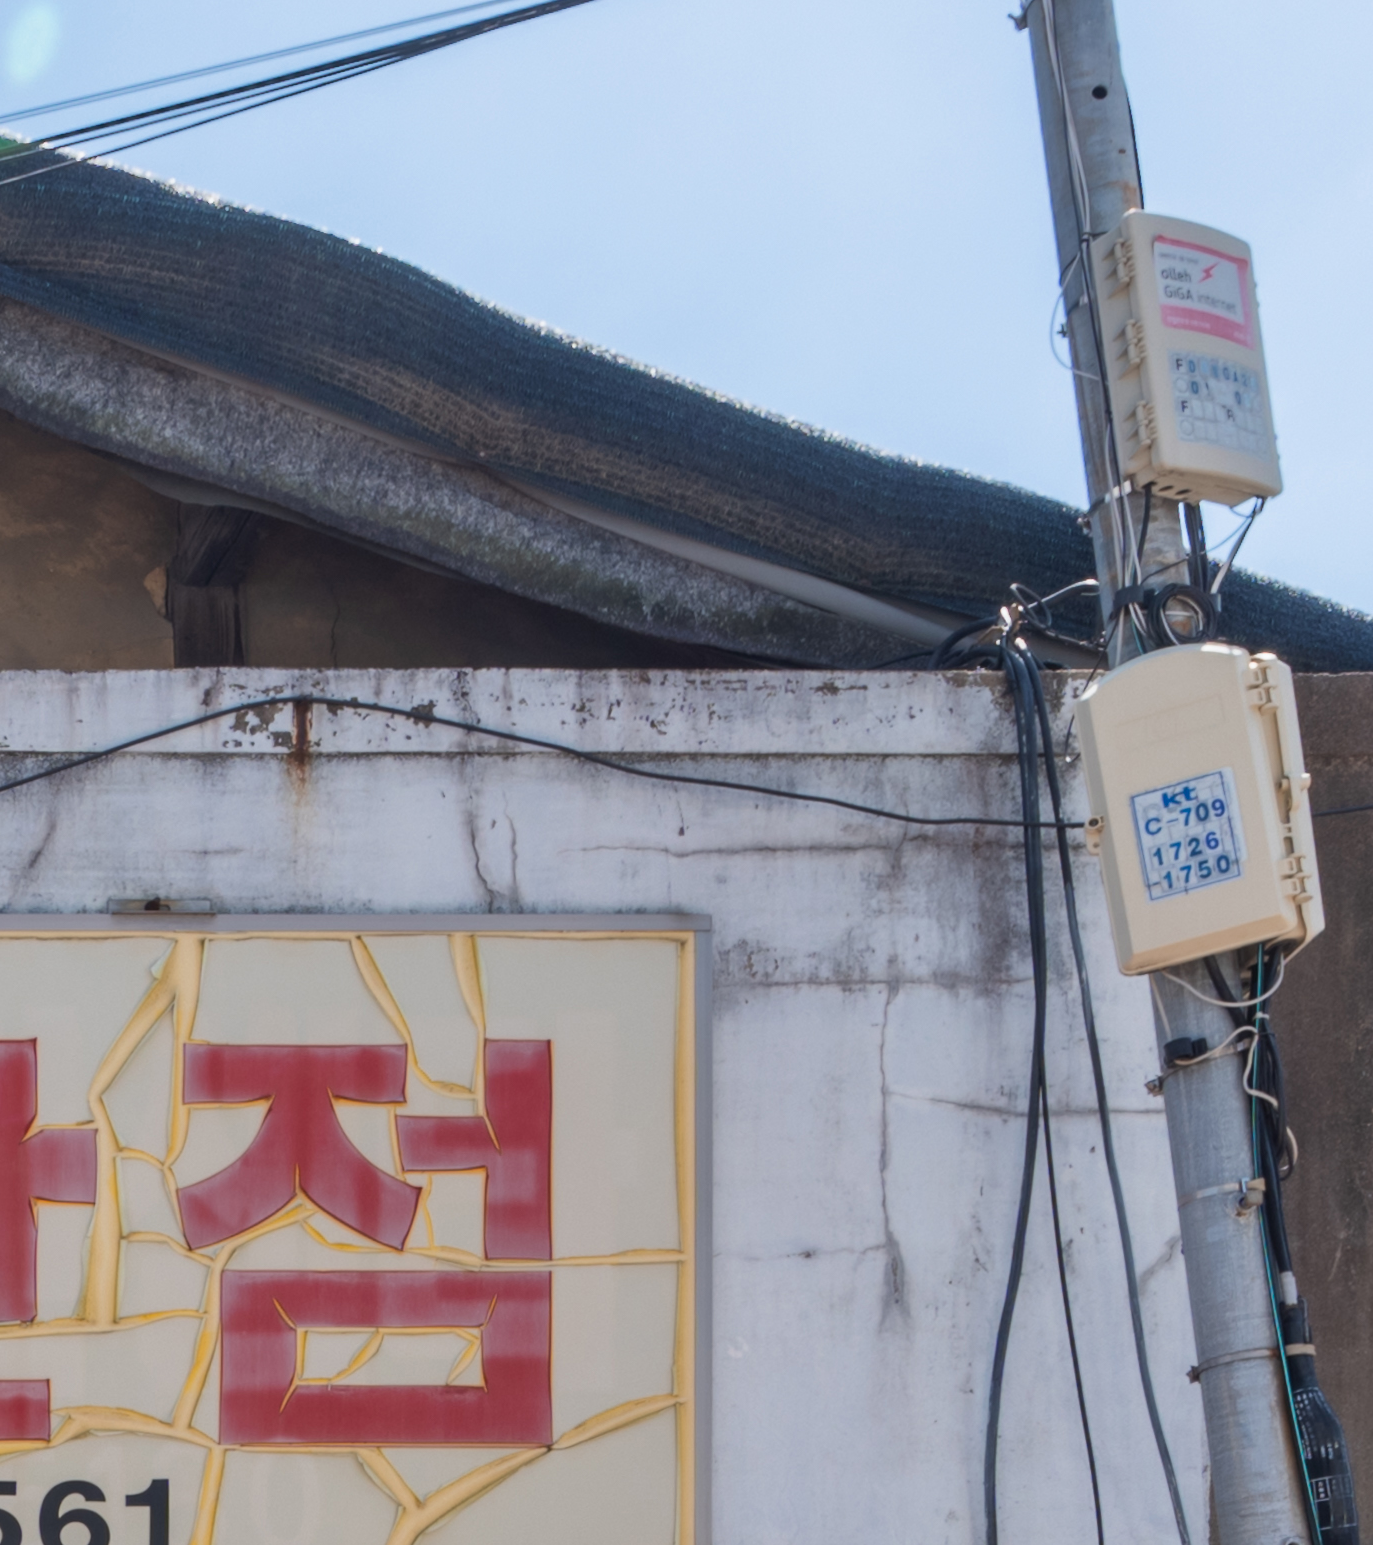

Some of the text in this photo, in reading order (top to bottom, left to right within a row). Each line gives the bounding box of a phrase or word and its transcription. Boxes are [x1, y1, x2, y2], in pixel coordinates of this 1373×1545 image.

[1161, 268, 1192, 283] olleh
[1161, 786, 1198, 808] kt
[1145, 799, 1226, 835] C-709
[1153, 831, 1220, 866] 1726
[1163, 854, 1230, 889] 1750
